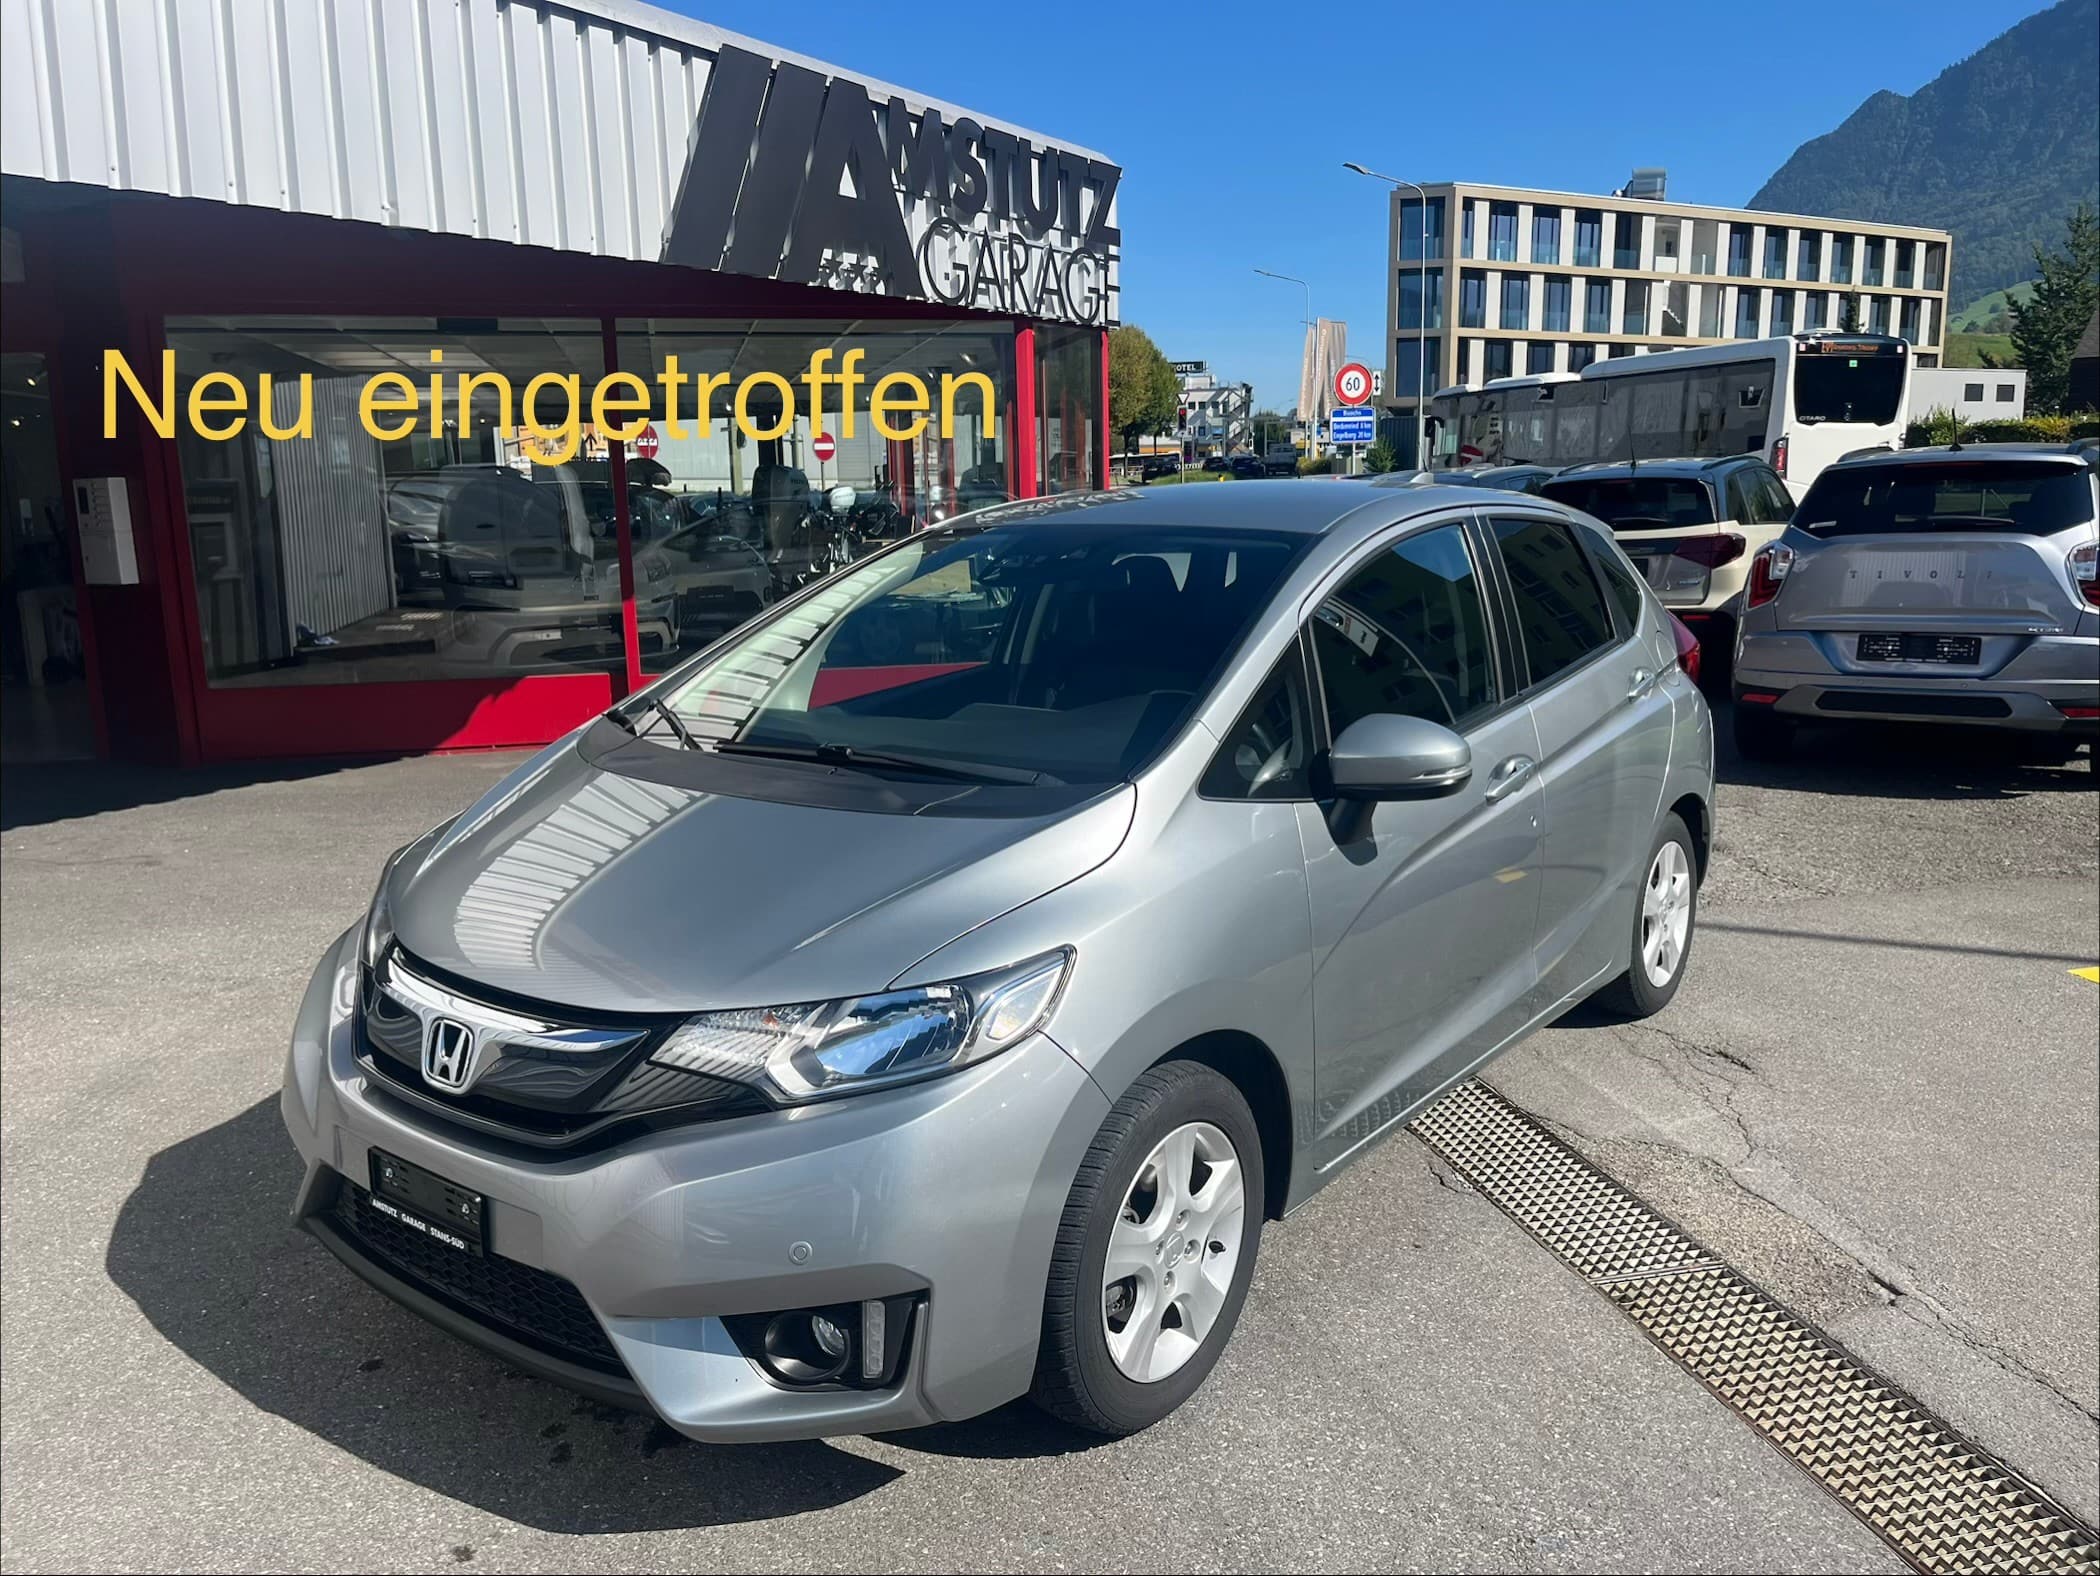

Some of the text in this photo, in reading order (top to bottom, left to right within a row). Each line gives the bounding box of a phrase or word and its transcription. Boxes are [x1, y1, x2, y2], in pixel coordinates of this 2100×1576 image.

[782, 76, 1122, 299] AMSTUTZ
[917, 216, 1121, 327] GARAGE
[1346, 377, 1360, 391] 60
[1849, 571, 1993, 580] TIVOLI
[371, 1198, 398, 1218] AMSTUTZ
[401, 1213, 427, 1232] GARAGE
